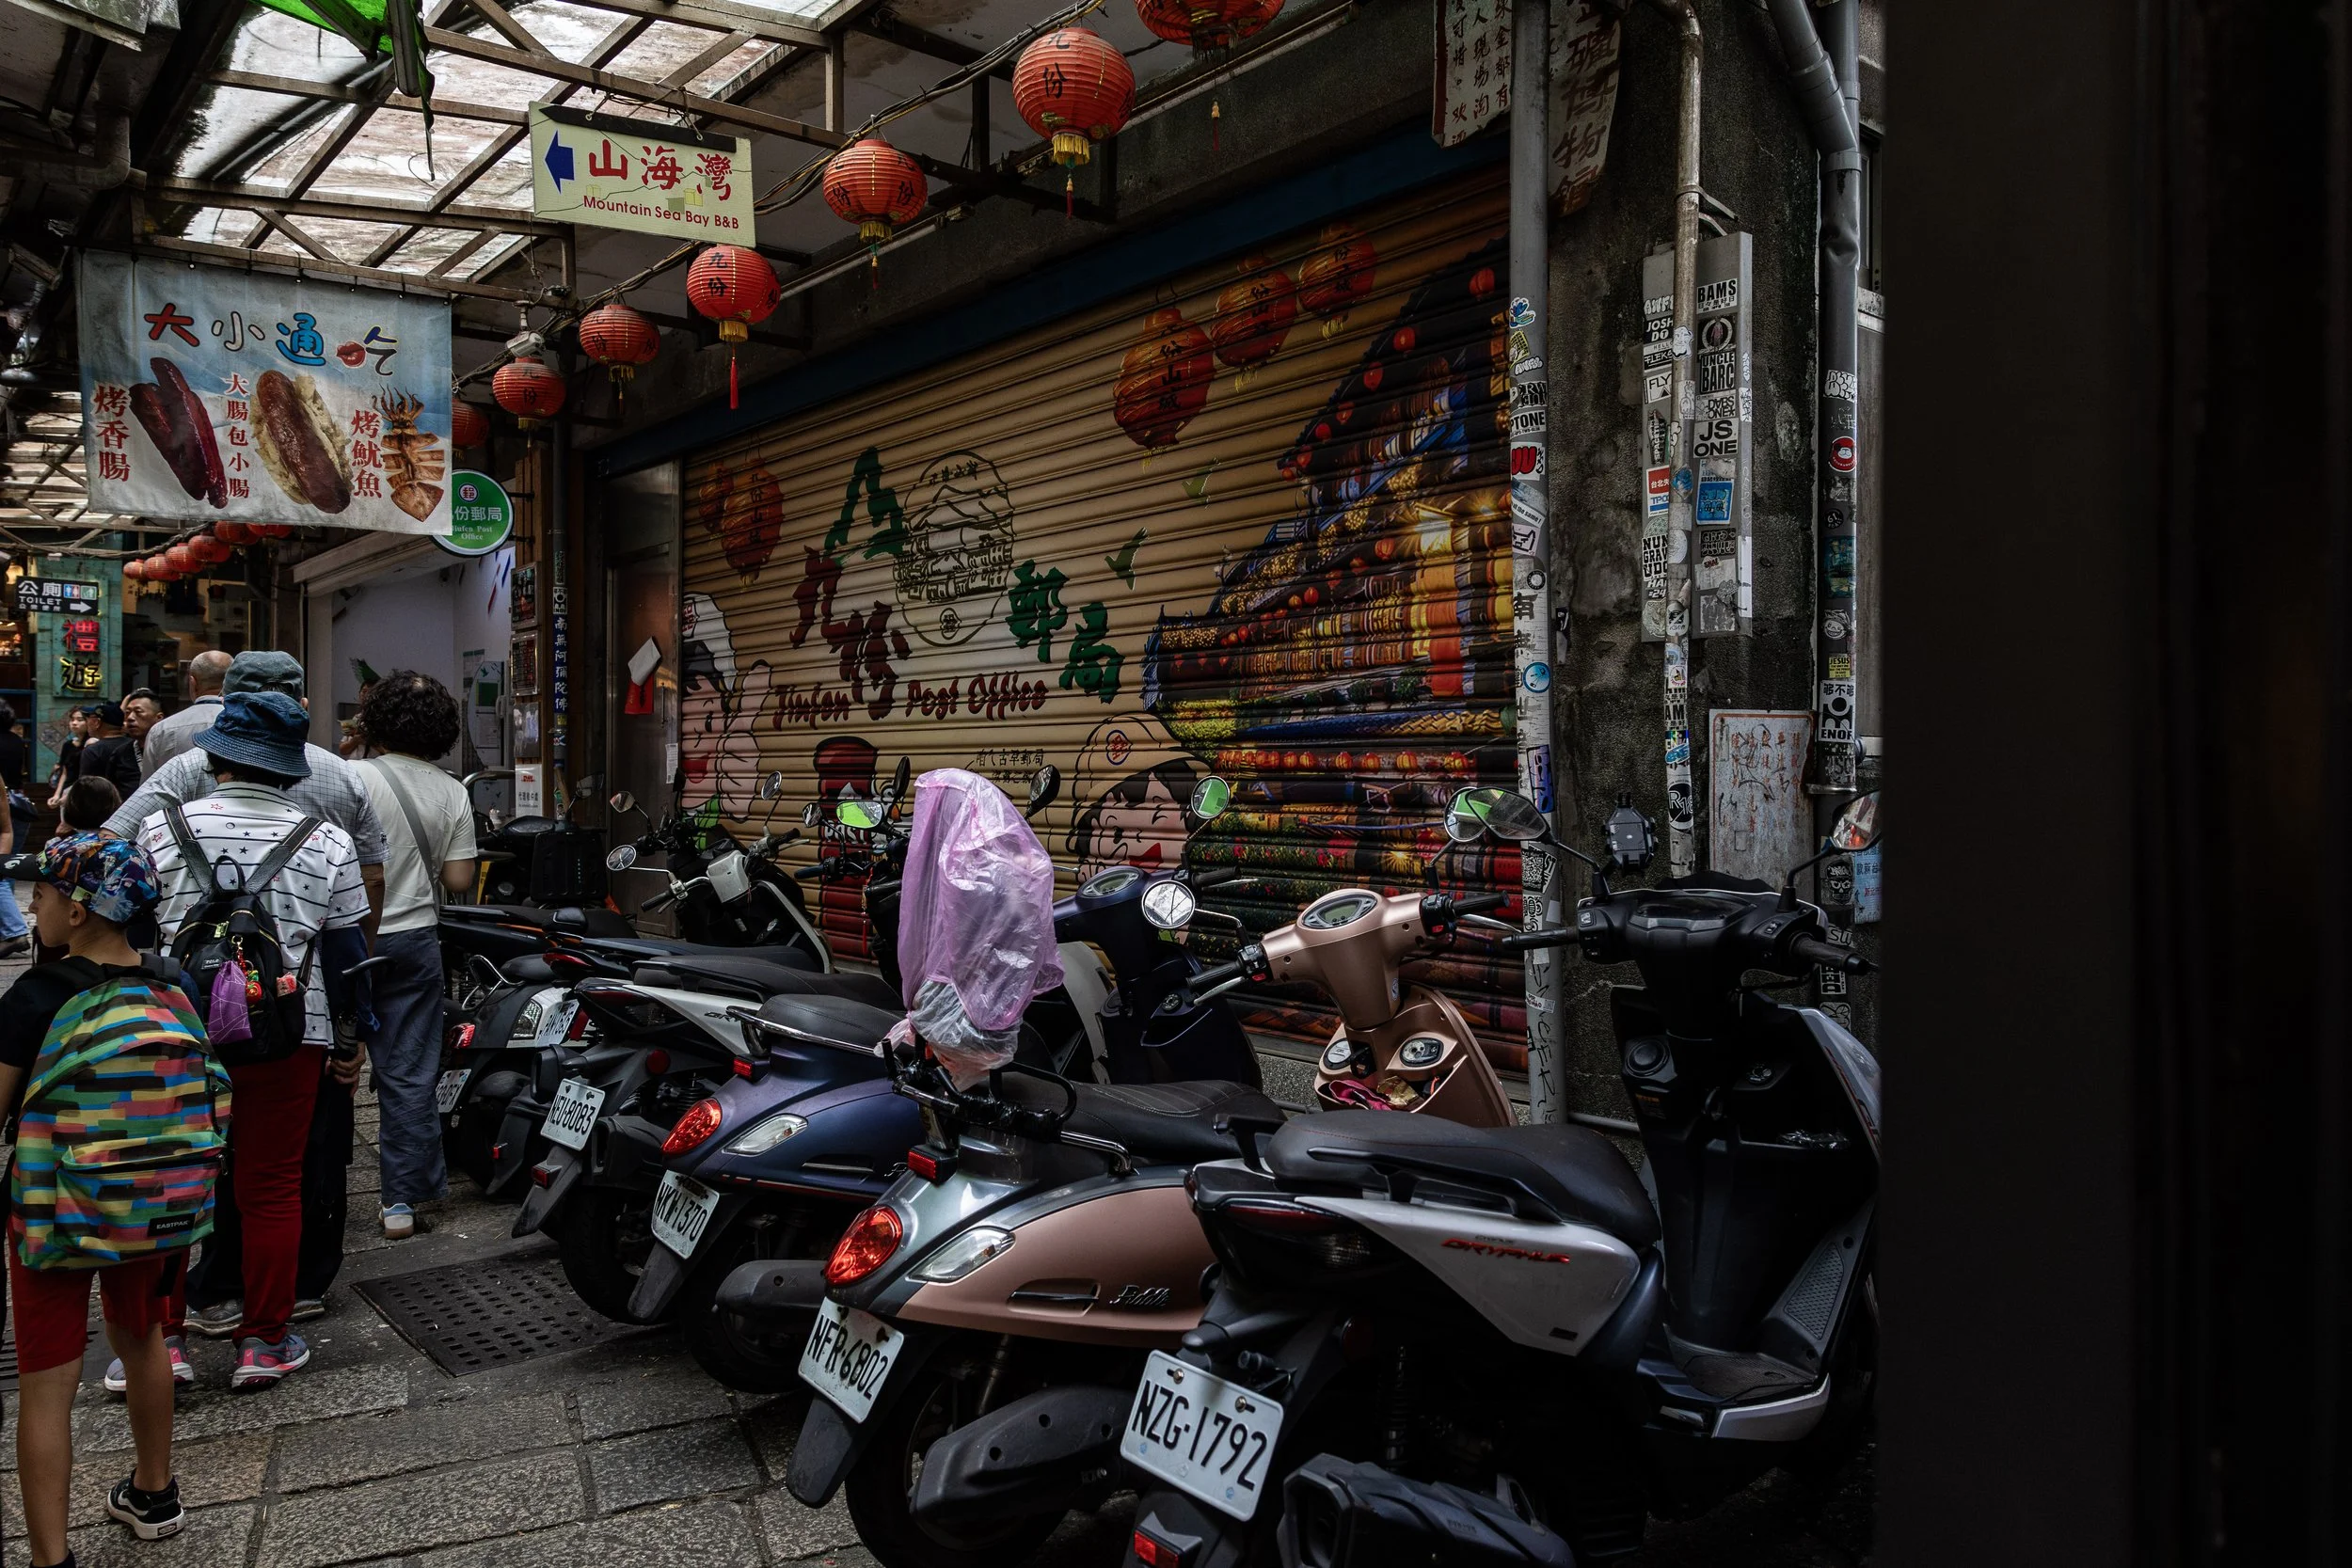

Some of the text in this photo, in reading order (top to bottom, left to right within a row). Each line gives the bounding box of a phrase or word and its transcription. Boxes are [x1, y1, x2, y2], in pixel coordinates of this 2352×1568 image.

[1042, 33, 1071, 100] 九份
[589, 139, 732, 201] 山海灣
[583, 196, 739, 230] Mountain Sea Bay B&B
[707, 251, 728, 297] 九份
[1698, 279, 1736, 303] BAMS
[1703, 353, 1734, 367] UNCLE
[94, 386, 131, 483] 烤香腸
[224, 372, 250, 499] 大腸包小腸
[1694, 439, 1737, 457] ONE
[1699, 420, 1733, 441] JS
[351, 410, 383, 499] 烤魷魚
[452, 506, 502, 522] 份郵局
[19, 596, 62, 605] TOILET
[905, 676, 960, 721] Post
[968, 672, 1048, 721] Office
[807, 1314, 888, 1401] NFR-6802
[1132, 1380, 1267, 1492] NZG-1792
